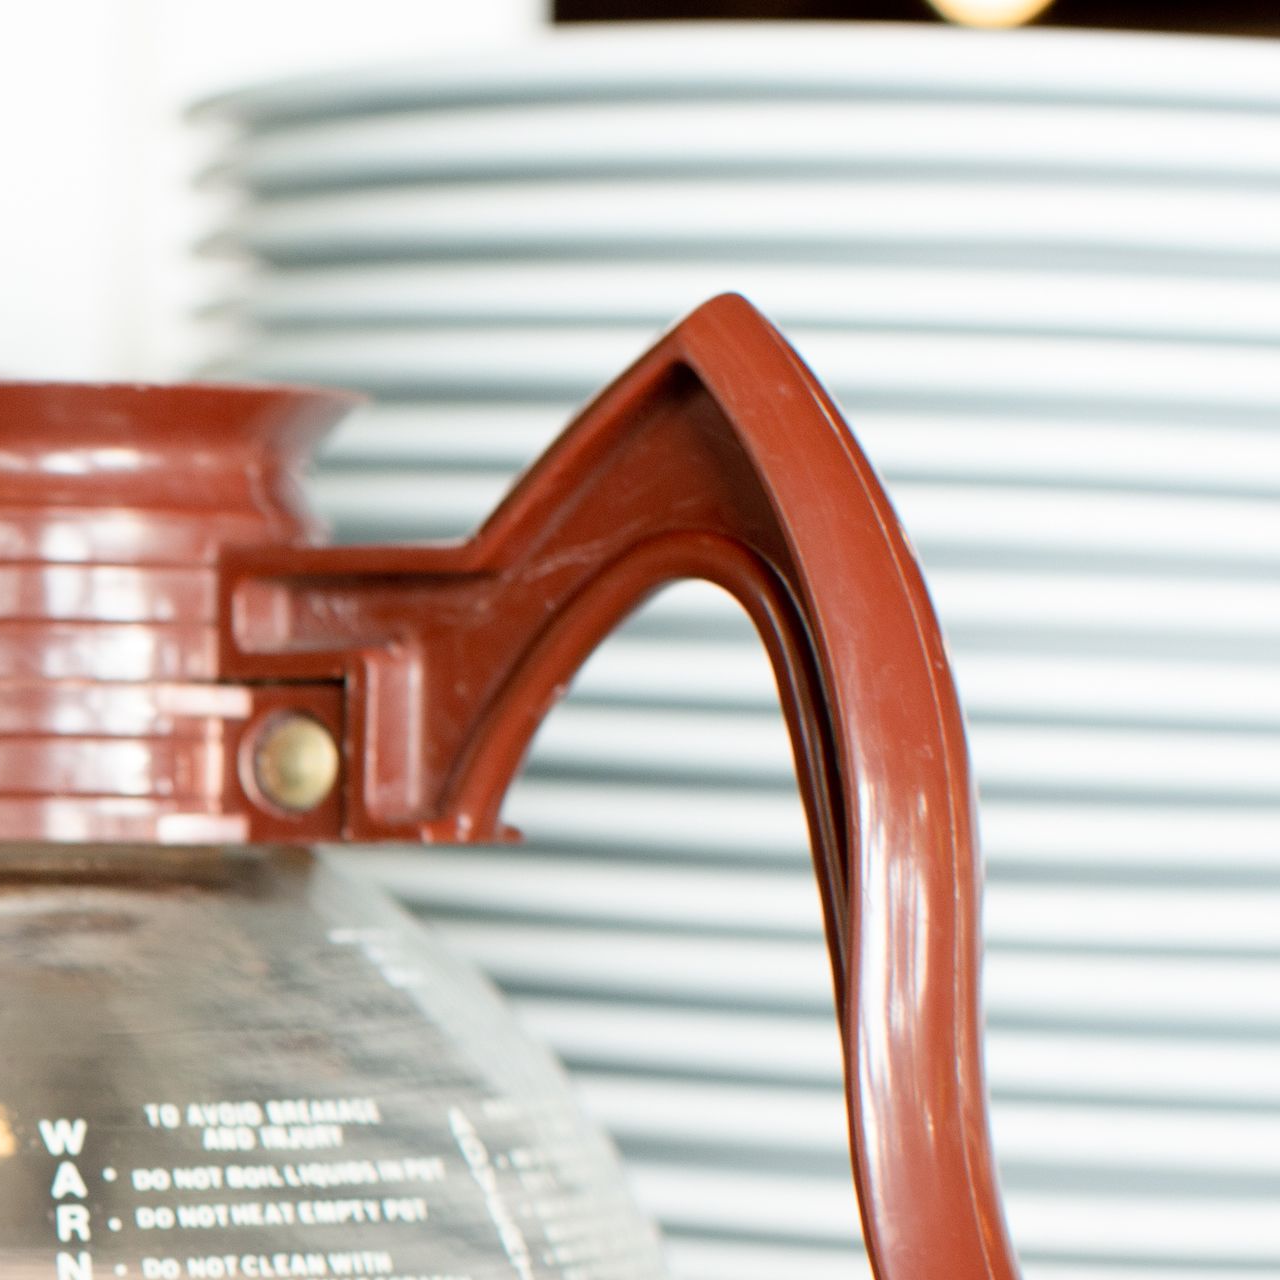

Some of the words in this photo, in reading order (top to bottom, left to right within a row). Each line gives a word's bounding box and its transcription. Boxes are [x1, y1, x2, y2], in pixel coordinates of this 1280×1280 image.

[143, 1103, 180, 1128] TO
[131, 1168, 171, 1191] DO
[172, 1165, 223, 1189] NOT
[225, 1164, 284, 1189] BOIL
[135, 1206, 175, 1230] DO
[176, 1203, 228, 1228] NOT
[229, 1202, 295, 1226] HEAT
[141, 1258, 181, 1280] DO
[186, 1256, 238, 1278] NOT
[240, 1253, 327, 1277] CLEAN
[328, 1251, 393, 1274] WITH
